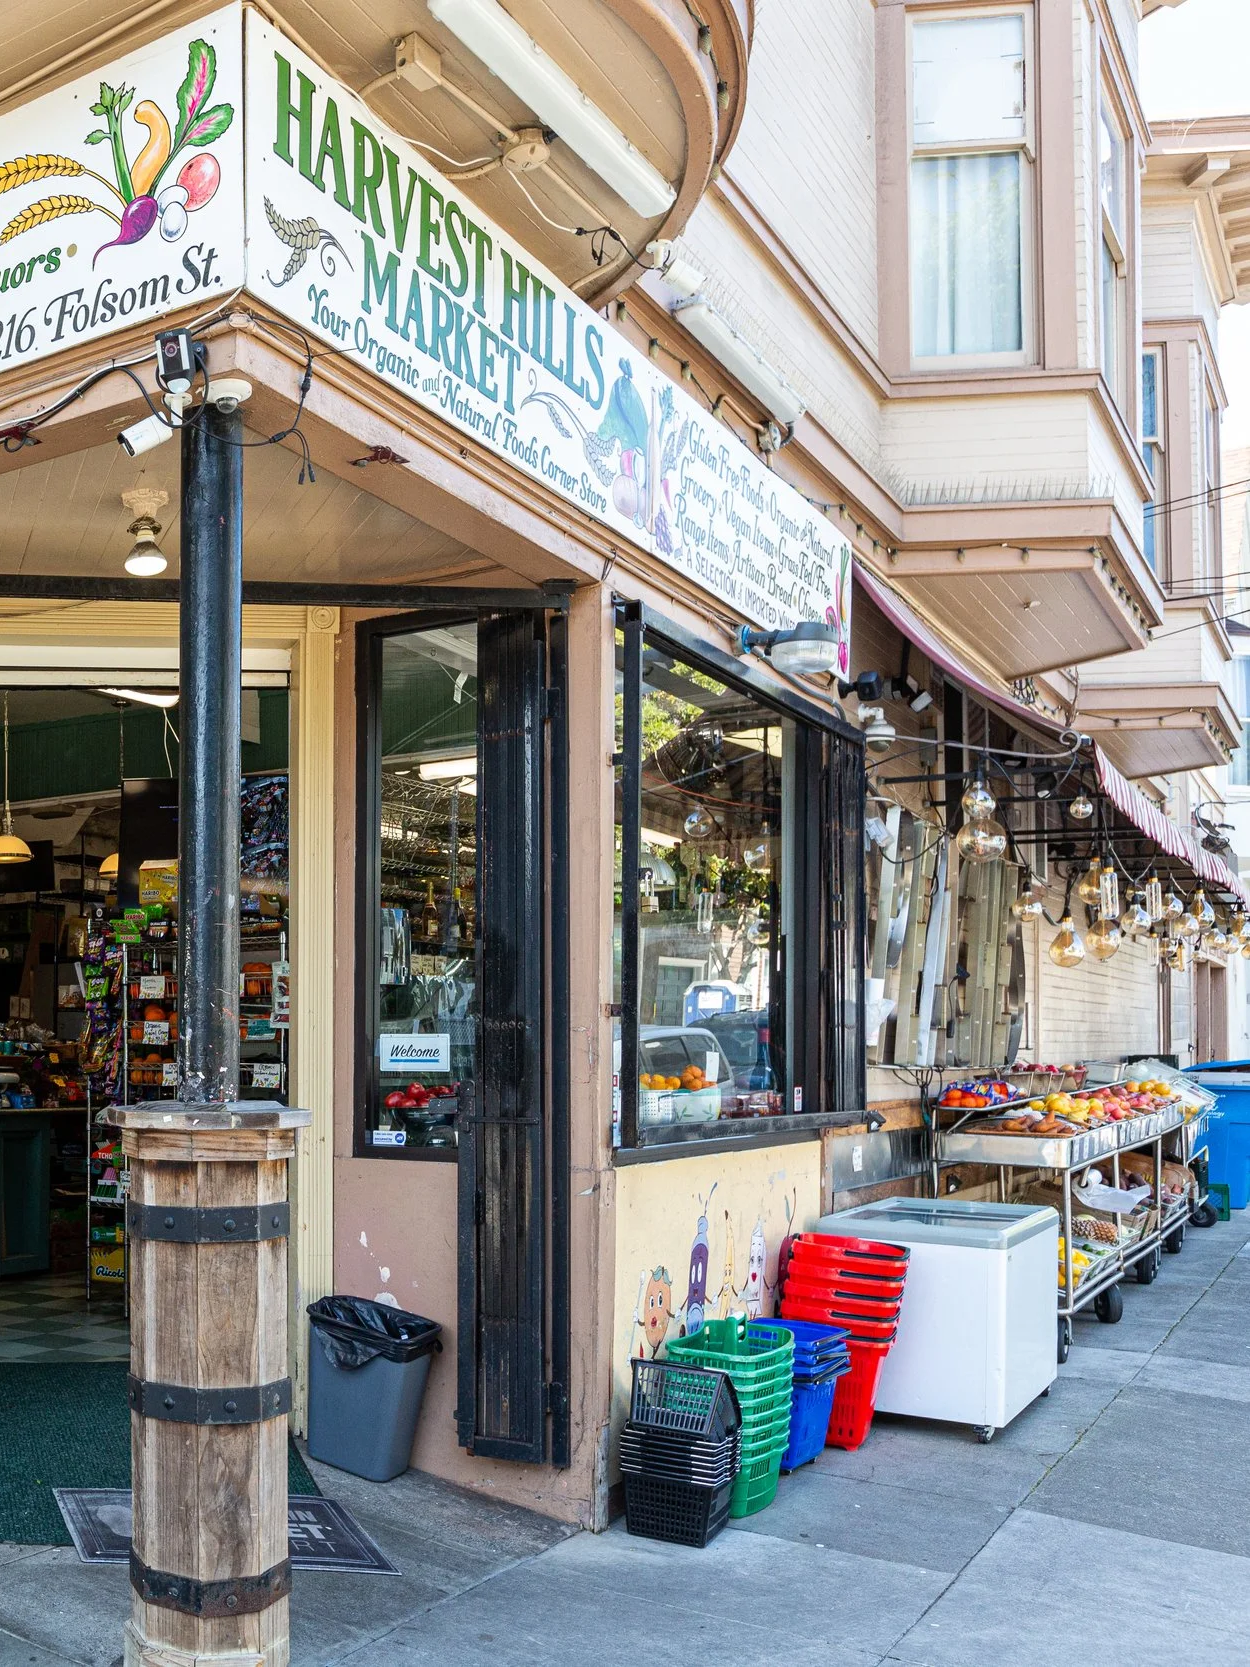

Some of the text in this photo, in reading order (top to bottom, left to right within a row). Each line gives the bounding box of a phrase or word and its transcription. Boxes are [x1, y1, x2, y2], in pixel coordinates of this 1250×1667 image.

[273, 50, 605, 411] HARVEST HILLS
[44, 274, 170, 342] Folsom
[176, 243, 222, 294] St.
[360, 231, 521, 414] MARKET
[308, 283, 607, 513] Your Organic and Natural Foods Corner Store
[674, 493, 706, 547] Range
[706, 519, 729, 564] Items
[728, 540, 765, 589] Artisan
[767, 563, 797, 608] Bread
[681, 456, 717, 518] Grocery
[722, 490, 750, 541] Vegan
[752, 515, 775, 559] Items
[778, 537, 799, 578] Grass
[689, 420, 717, 474] Gluten
[718, 444, 740, 491] Free
[740, 464, 764, 514] Foods
[770, 492, 800, 541] Organic
[806, 521, 835, 569] Natural
[687, 547, 693, 569] A
[695, 552, 736, 600] SELECTION
[745, 587, 777, 624] IMPORTED
[390, 1044, 440, 1058] Welcome
[288, 1510, 317, 1522] IN
[291, 1539, 336, 1552] RT
